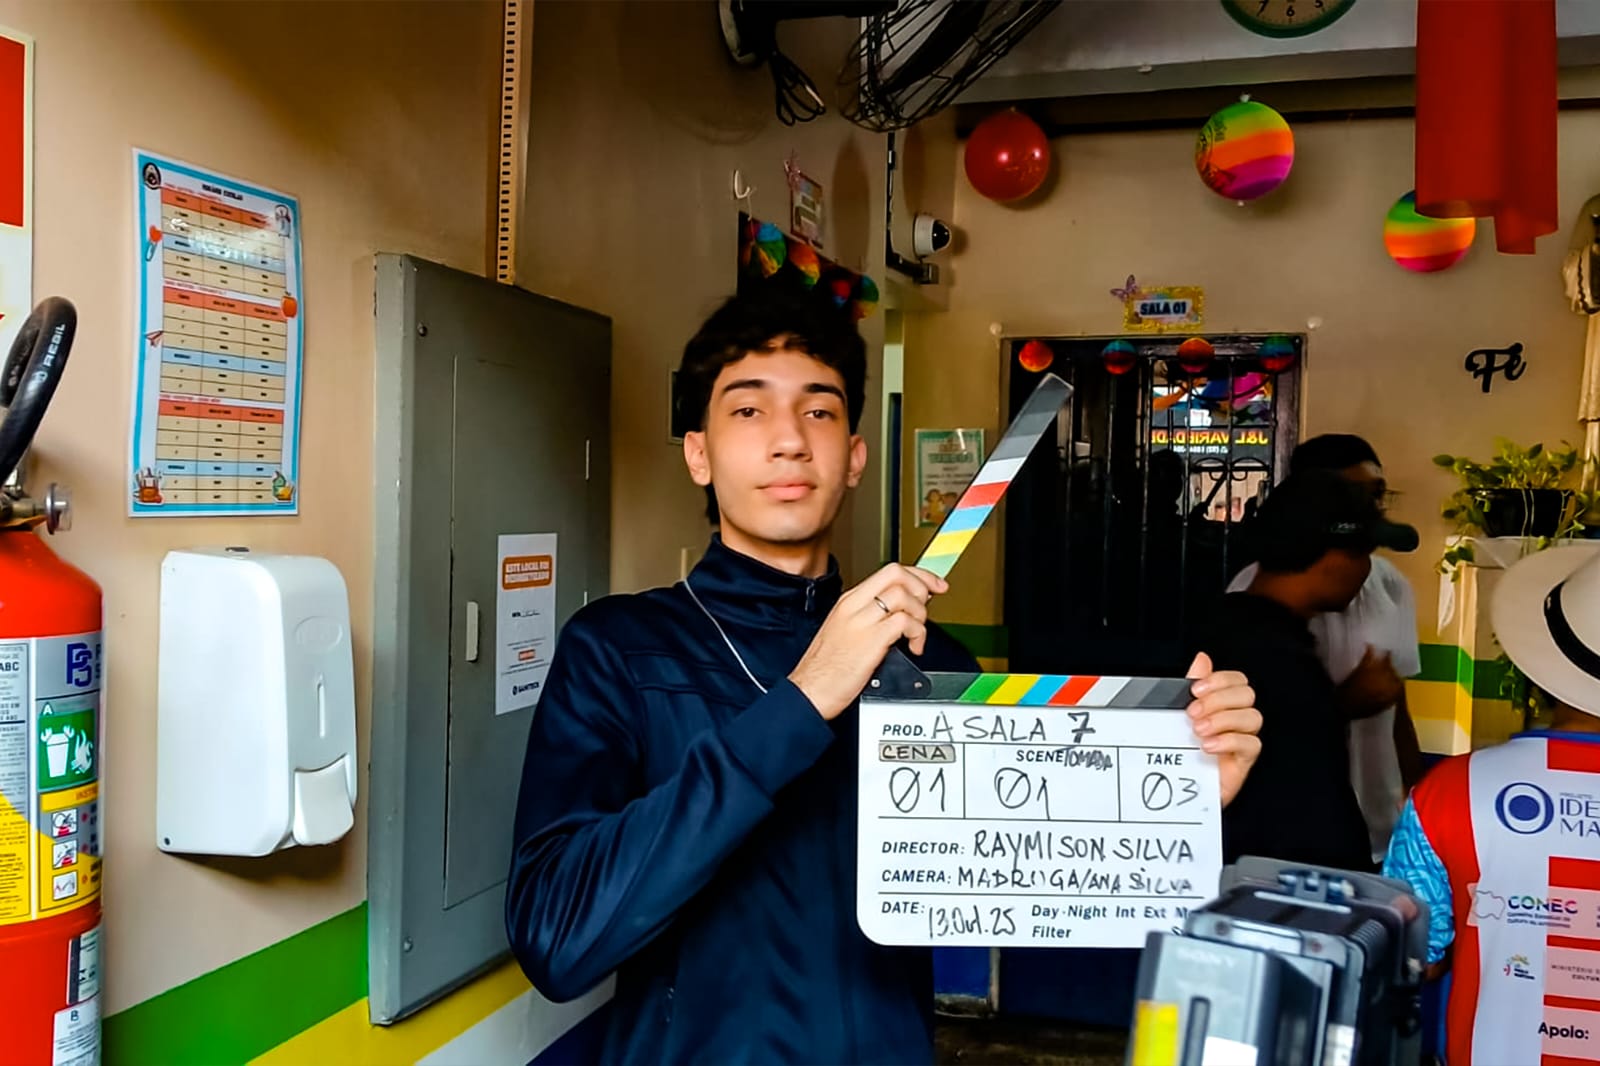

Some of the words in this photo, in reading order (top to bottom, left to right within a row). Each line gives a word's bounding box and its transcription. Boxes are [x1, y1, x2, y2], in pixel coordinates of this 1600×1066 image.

[1286, 5, 1295, 17] 6
[1140, 302, 1170, 316] SALA
[1172, 302, 1187, 315] 01
[1464, 342, 1527, 393] Fé
[882, 724, 927, 737] PROD.
[931, 711, 954, 742] A
[963, 714, 1046, 742] SALA
[1068, 711, 1096, 743] 7
[882, 744, 947, 760] CENA
[1016, 749, 1064, 763] SCENE
[1146, 753, 1183, 766] TAKE
[881, 841, 965, 855] DIRECTOR:
[1112, 837, 1194, 863] SILVA
[881, 870, 952, 884] CAMERA:
[1128, 868, 1193, 894] SILVA
[881, 901, 926, 914] DATE:
[1115, 906, 1136, 918] Int
[1144, 906, 1166, 919] Ext
[1508, 895, 1578, 914] CONEC
[1032, 926, 1072, 938] Filter
